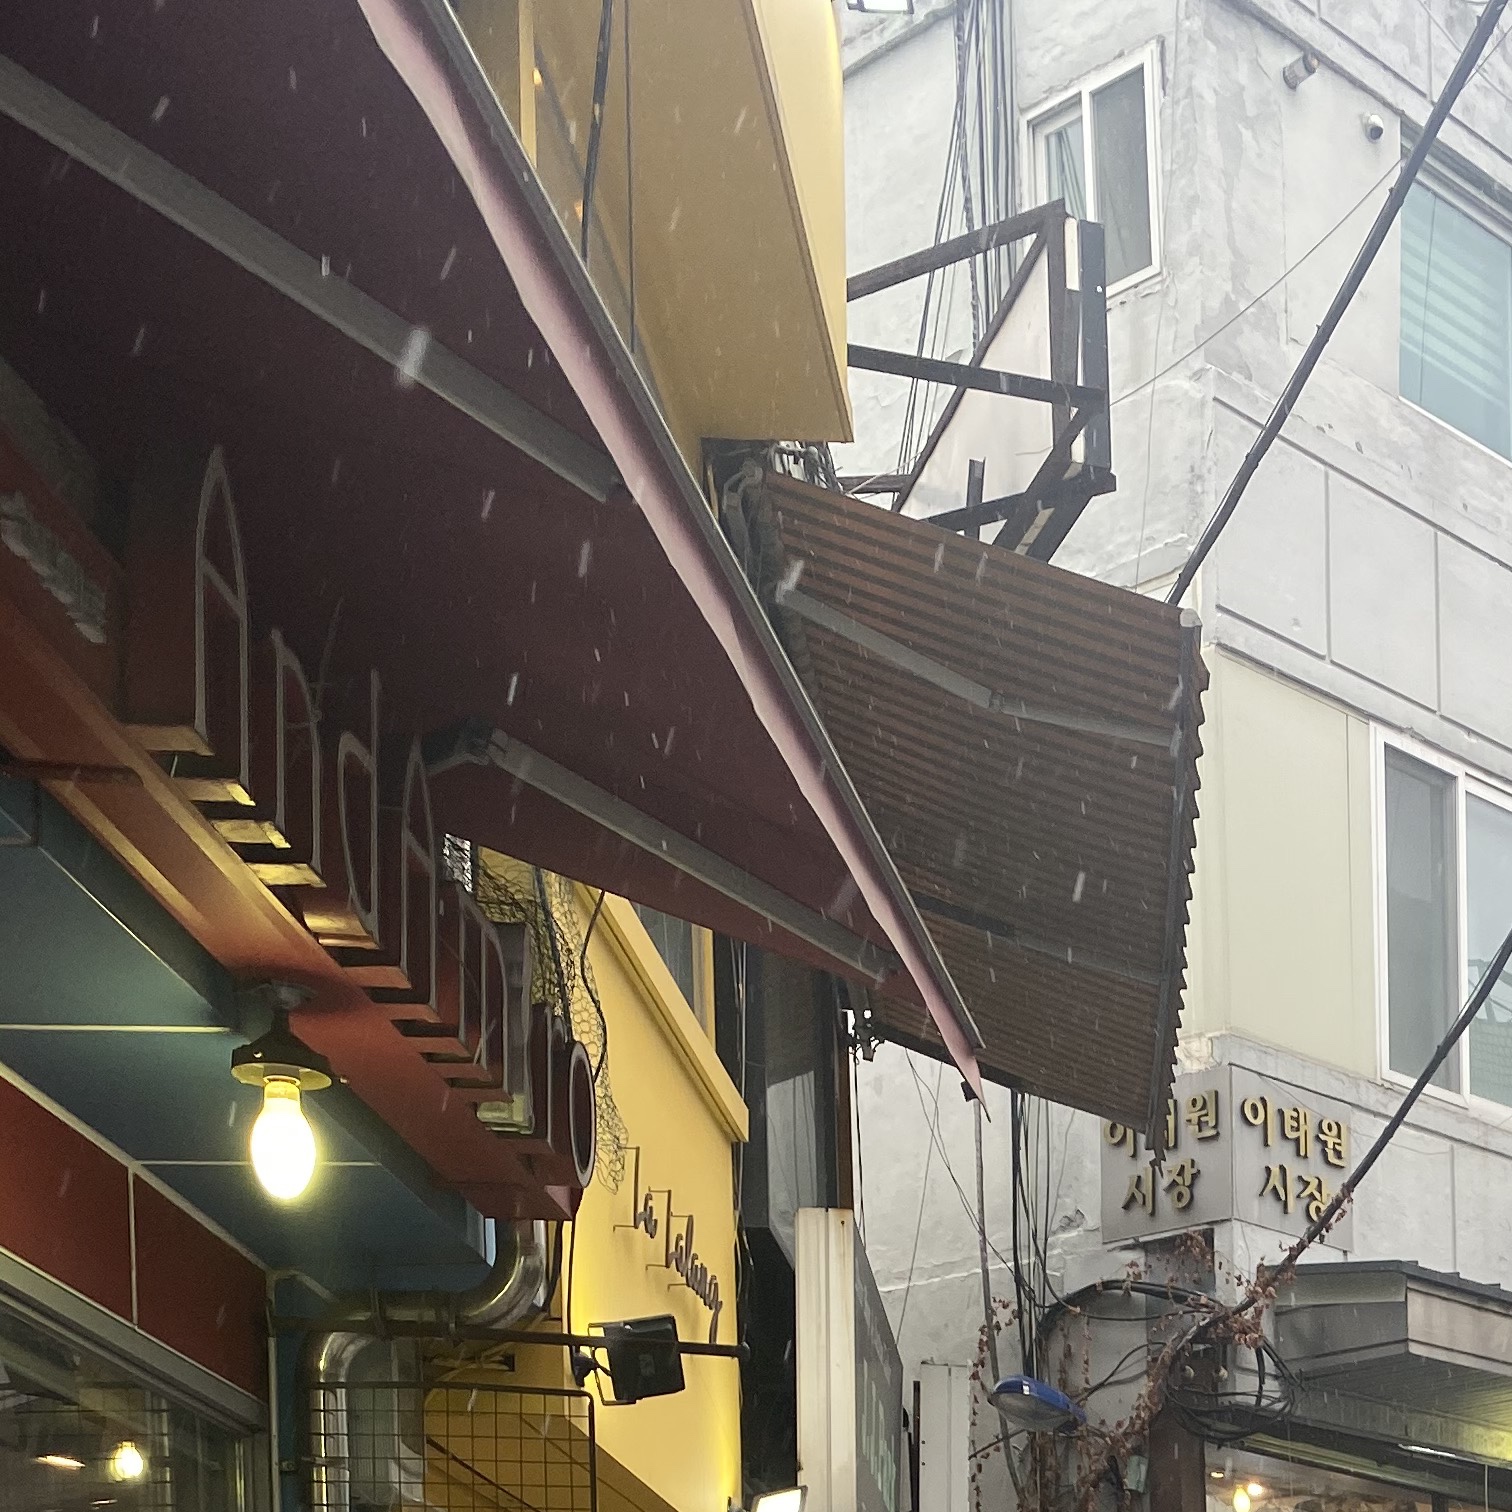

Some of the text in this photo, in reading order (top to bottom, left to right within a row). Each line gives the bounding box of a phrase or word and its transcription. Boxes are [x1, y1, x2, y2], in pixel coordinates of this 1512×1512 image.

[1242, 1097, 1347, 1168] 이태원
[1122, 1158, 1200, 1217] 시장
[1259, 1164, 1335, 1223] 시장
